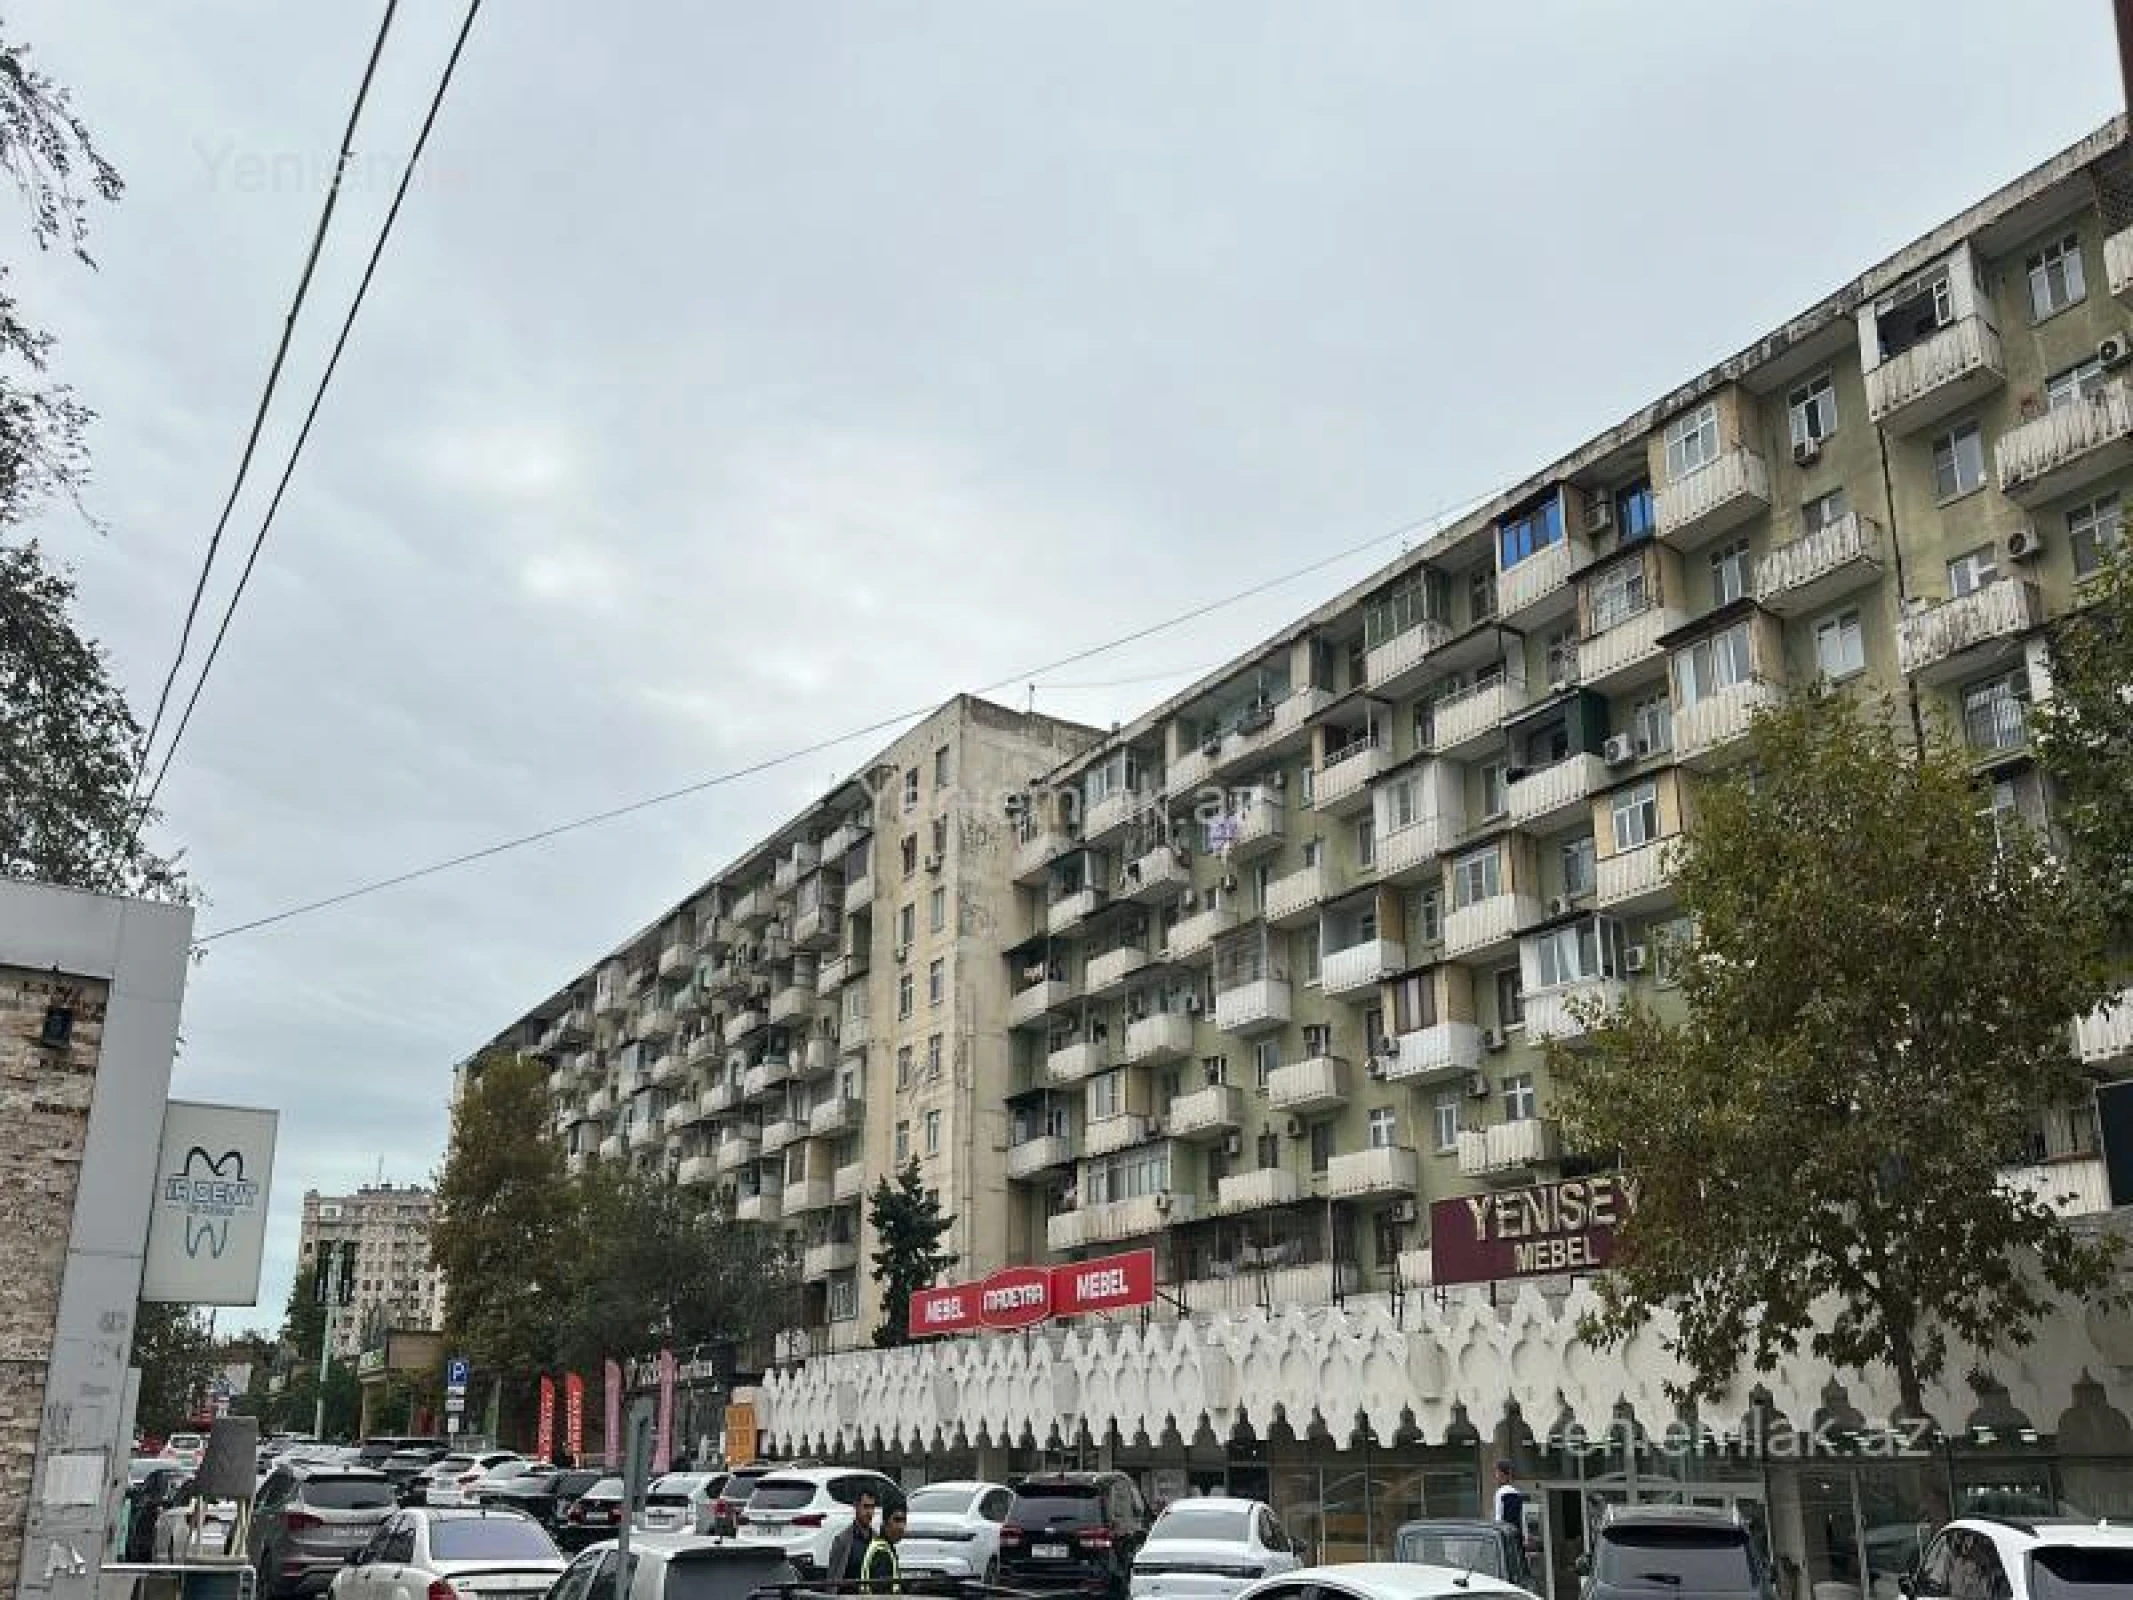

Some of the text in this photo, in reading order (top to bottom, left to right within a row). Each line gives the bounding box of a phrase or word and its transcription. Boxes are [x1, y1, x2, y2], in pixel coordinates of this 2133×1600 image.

[1466, 1175, 1641, 1241] YENISEY
[1514, 1236, 1600, 1273] MEBEL
[925, 1296, 966, 1324] MEBEL
[1077, 1268, 1129, 1303] MEBEL
[452, 1362, 465, 1381] P
